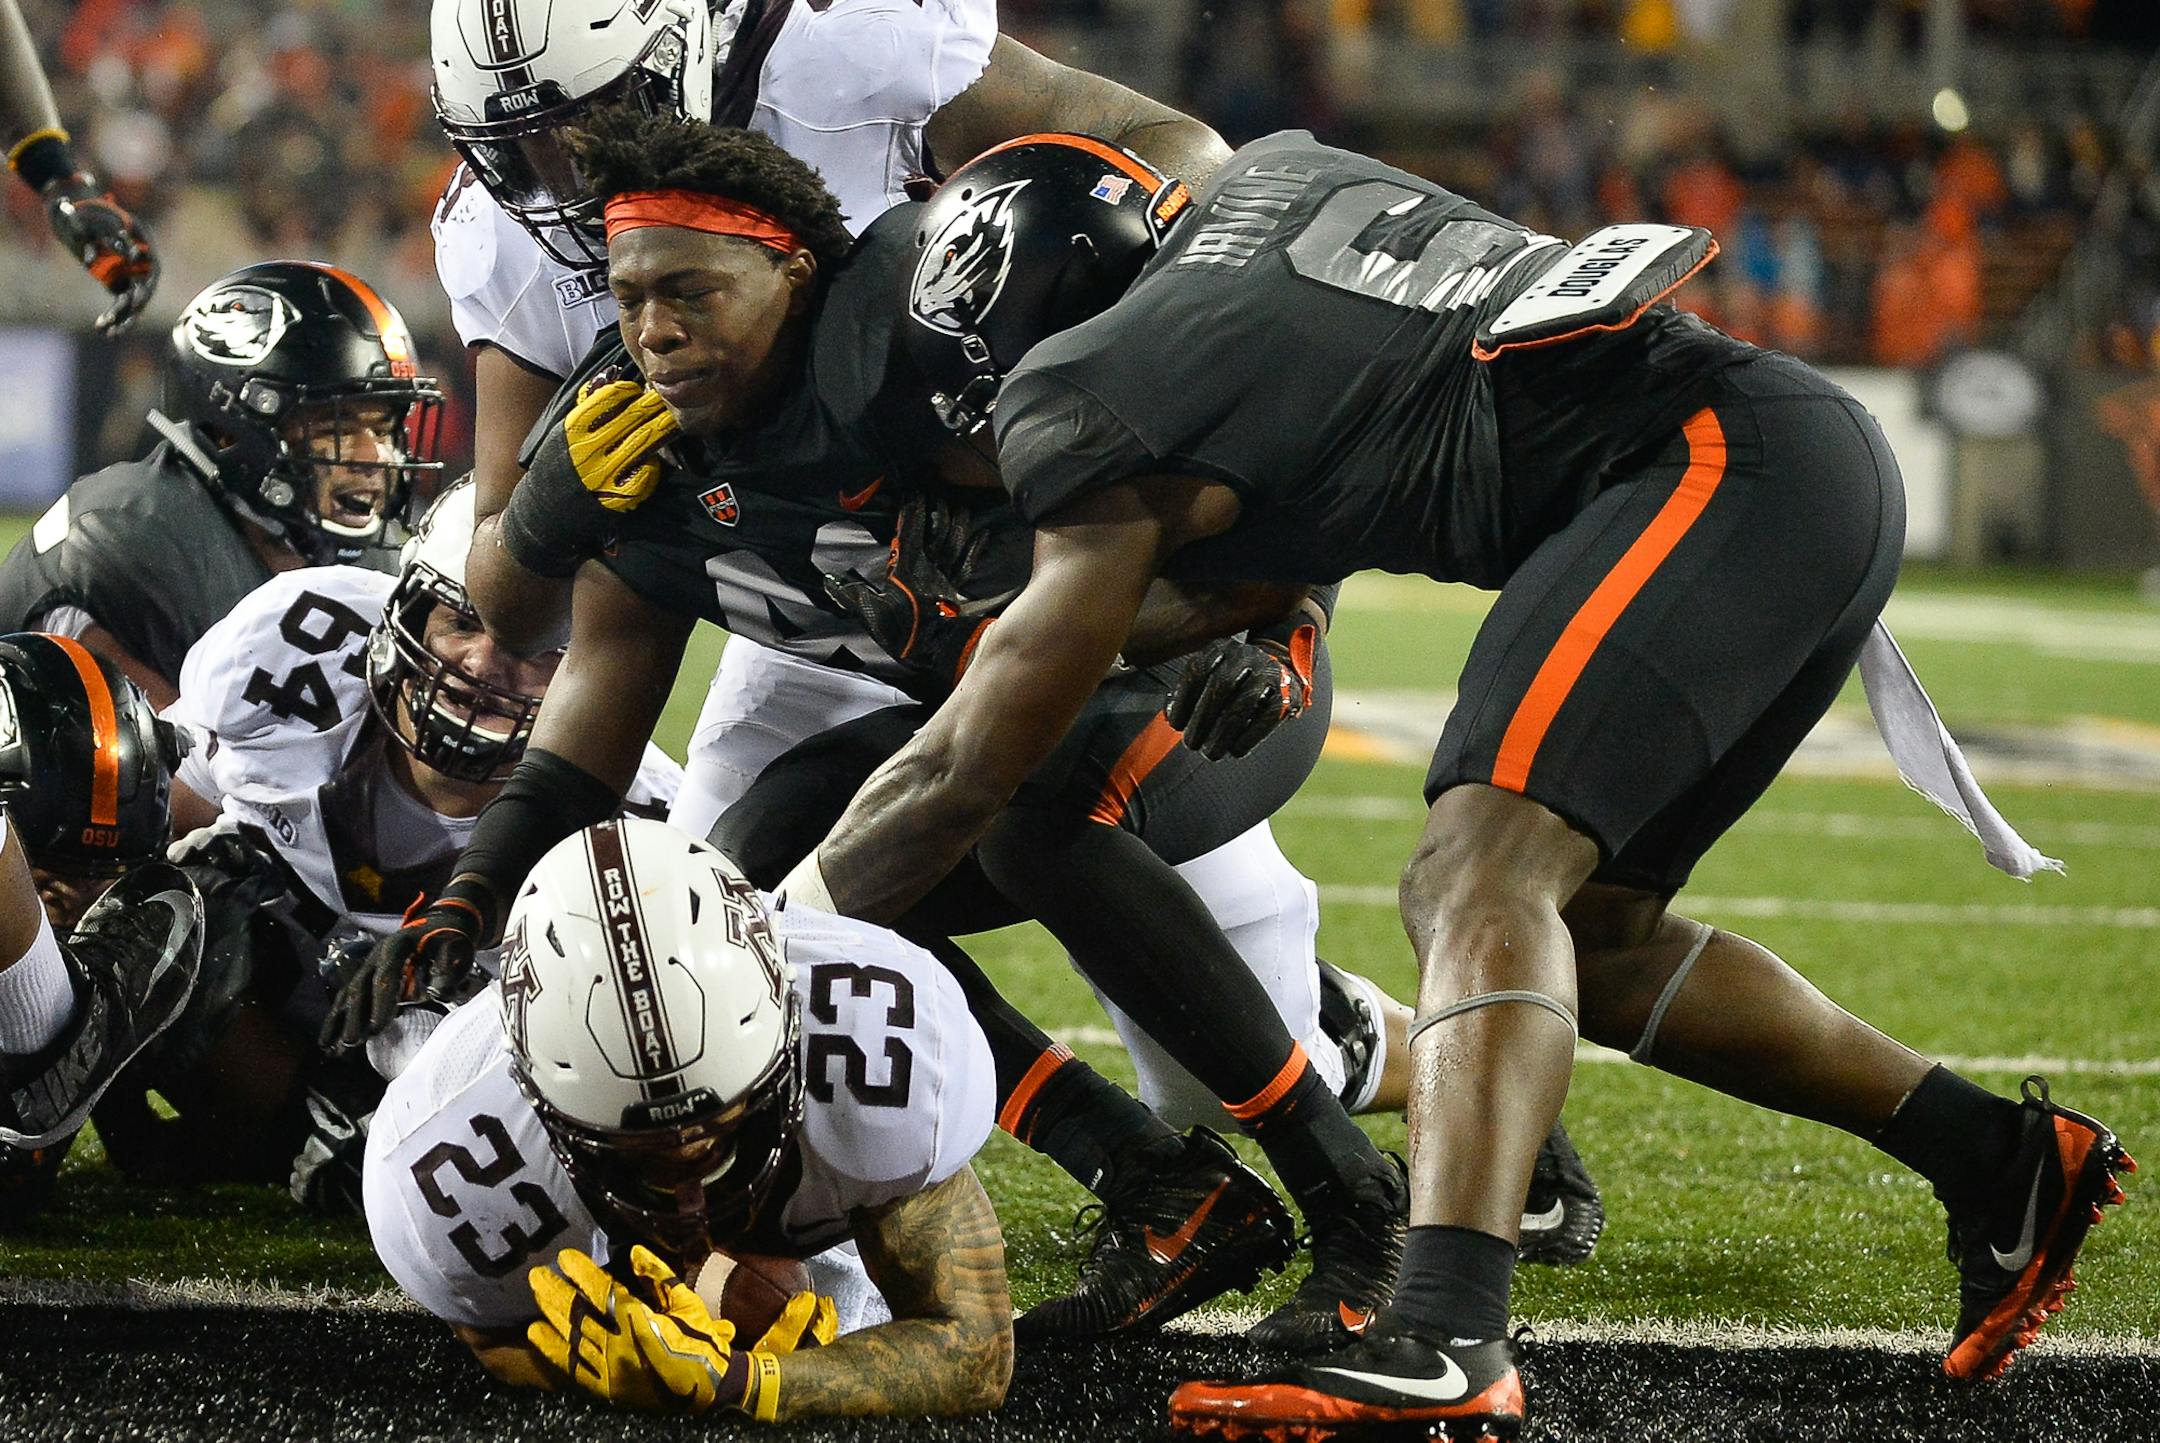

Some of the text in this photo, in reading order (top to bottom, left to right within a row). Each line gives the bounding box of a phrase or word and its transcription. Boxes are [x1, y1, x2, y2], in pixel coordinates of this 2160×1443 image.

[500, 89, 540, 113] ROW
[1177, 165, 1322, 267] IRVINE
[1547, 238, 1649, 297] DOUGLAS
[241, 590, 376, 734] 64
[82, 828, 119, 848] OSU
[603, 867, 661, 1069] ROW THE BOAT
[806, 962, 915, 1109] 23
[649, 1094, 696, 1122] ROW
[410, 1113, 570, 1278] 23
